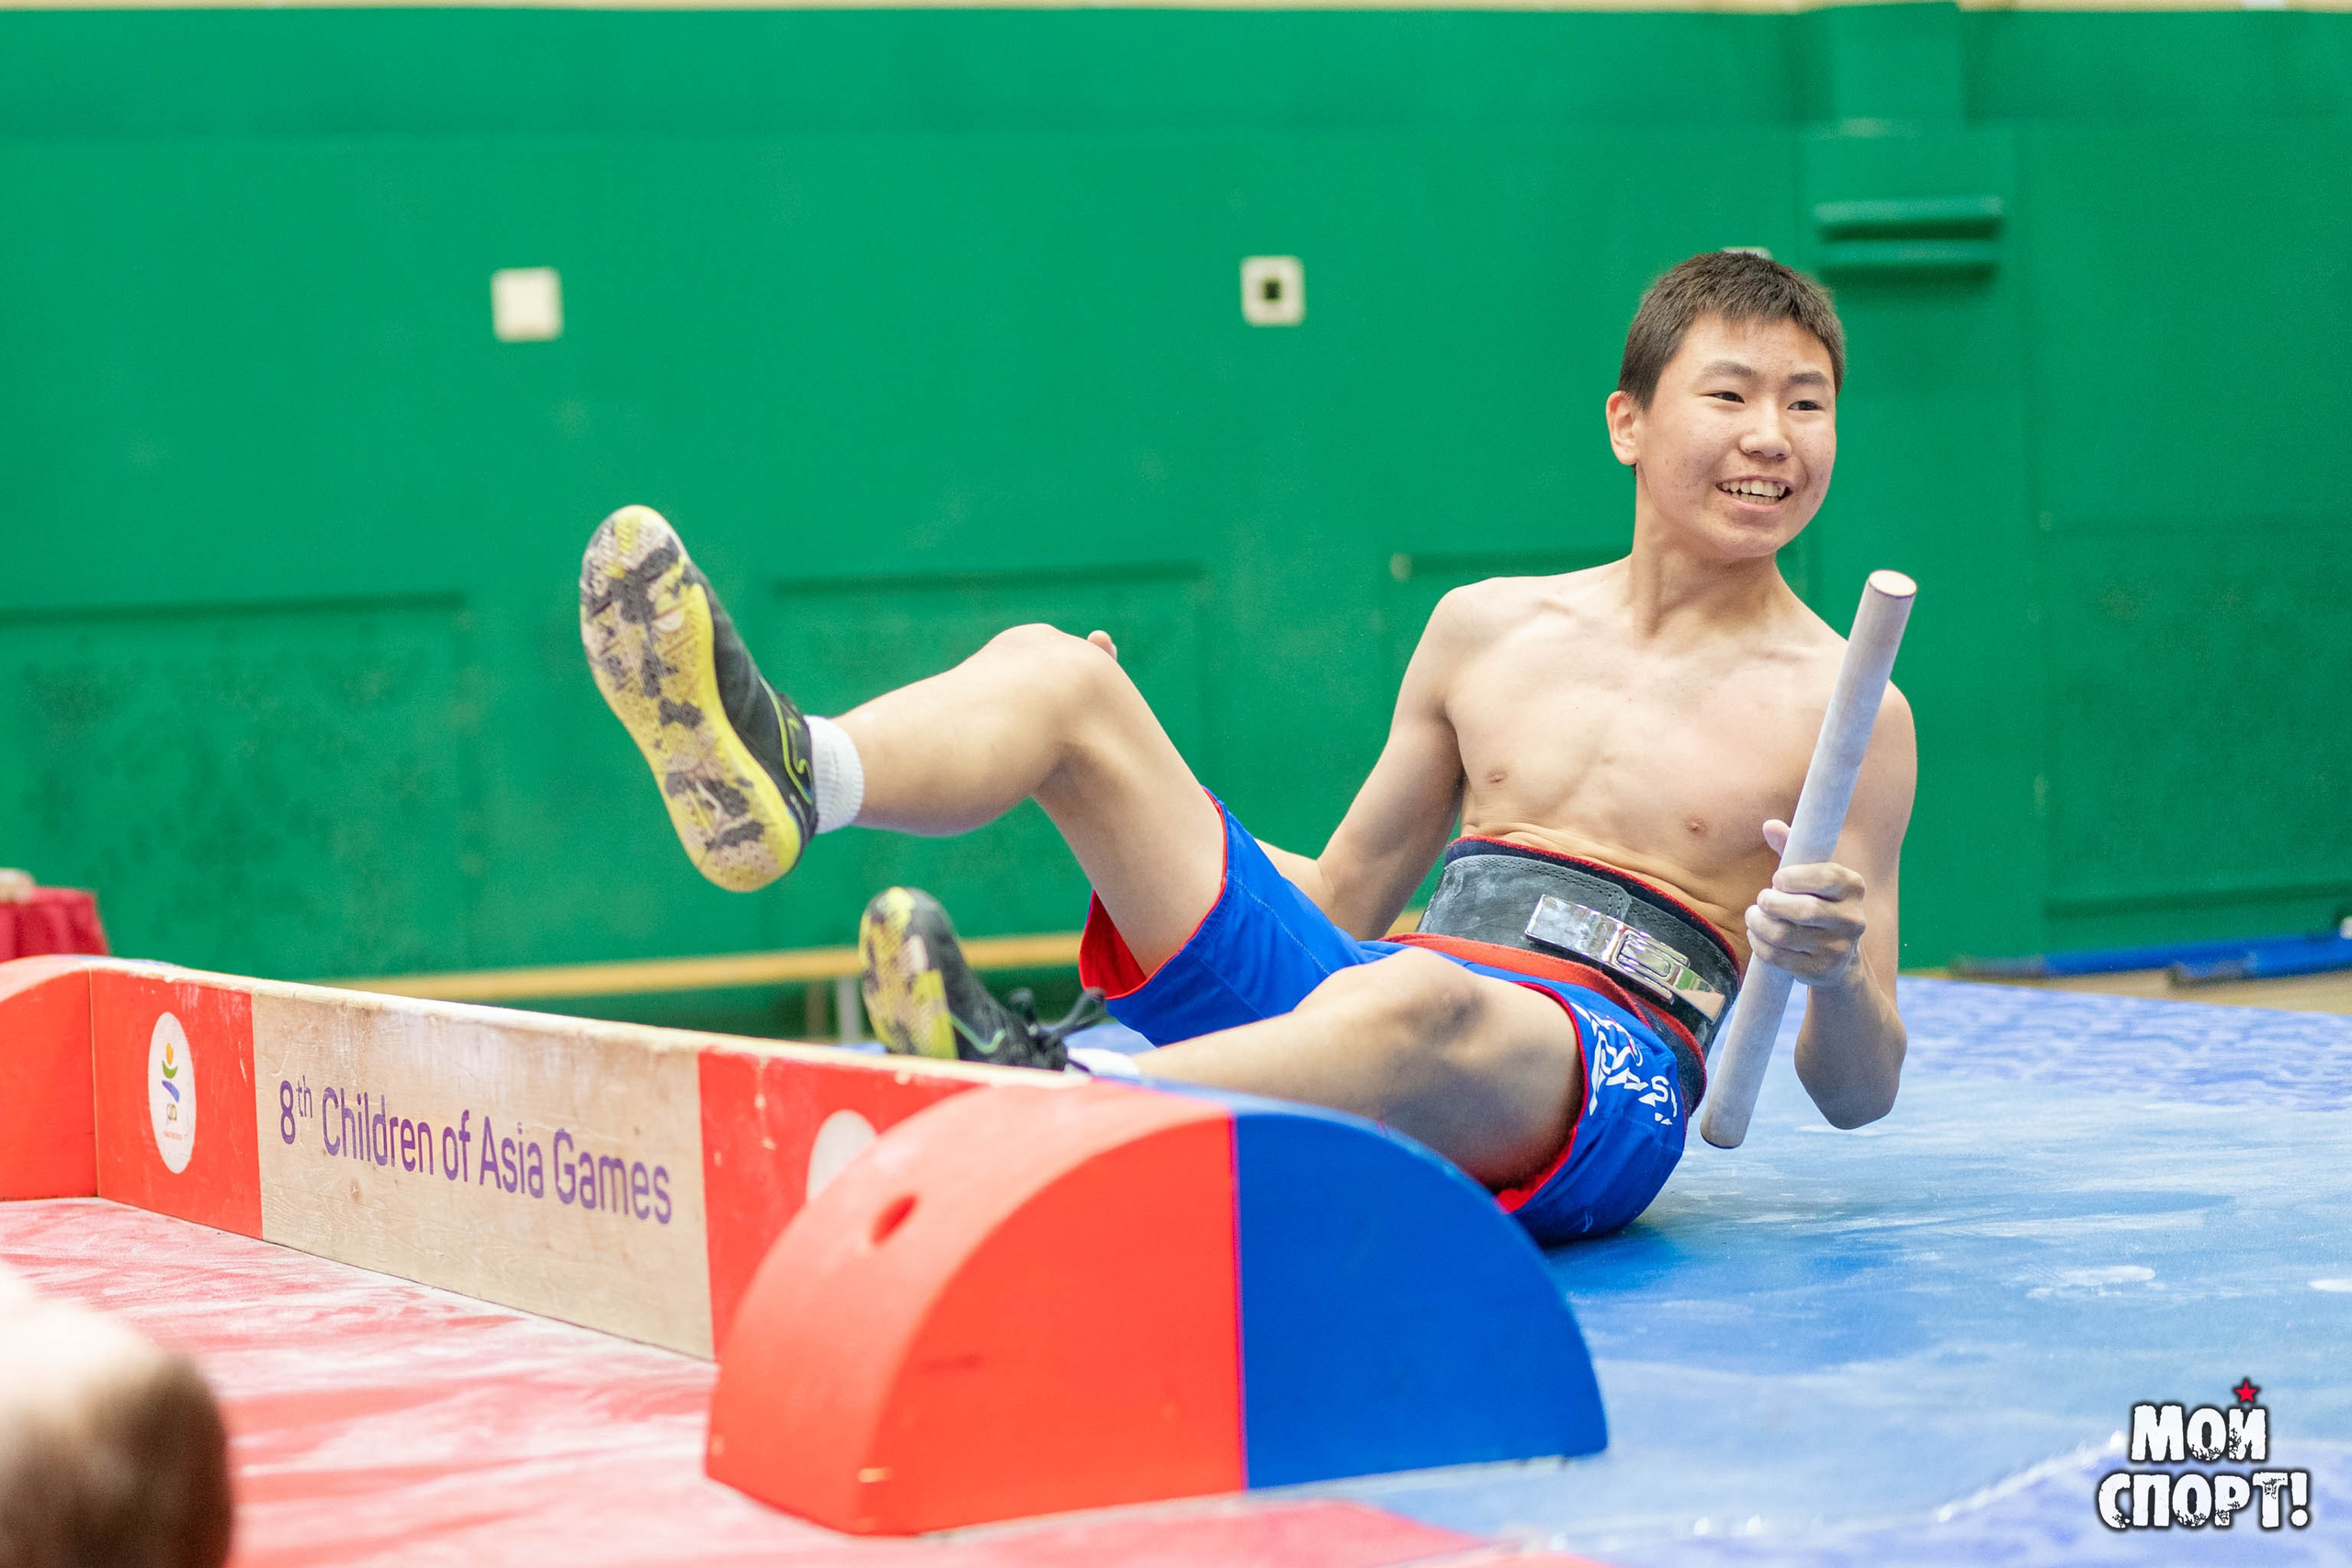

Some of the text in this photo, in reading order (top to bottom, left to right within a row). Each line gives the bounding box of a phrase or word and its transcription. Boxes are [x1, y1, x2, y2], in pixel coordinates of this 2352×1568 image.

[279, 1075, 673, 1225] 8th Children of Asia Games
